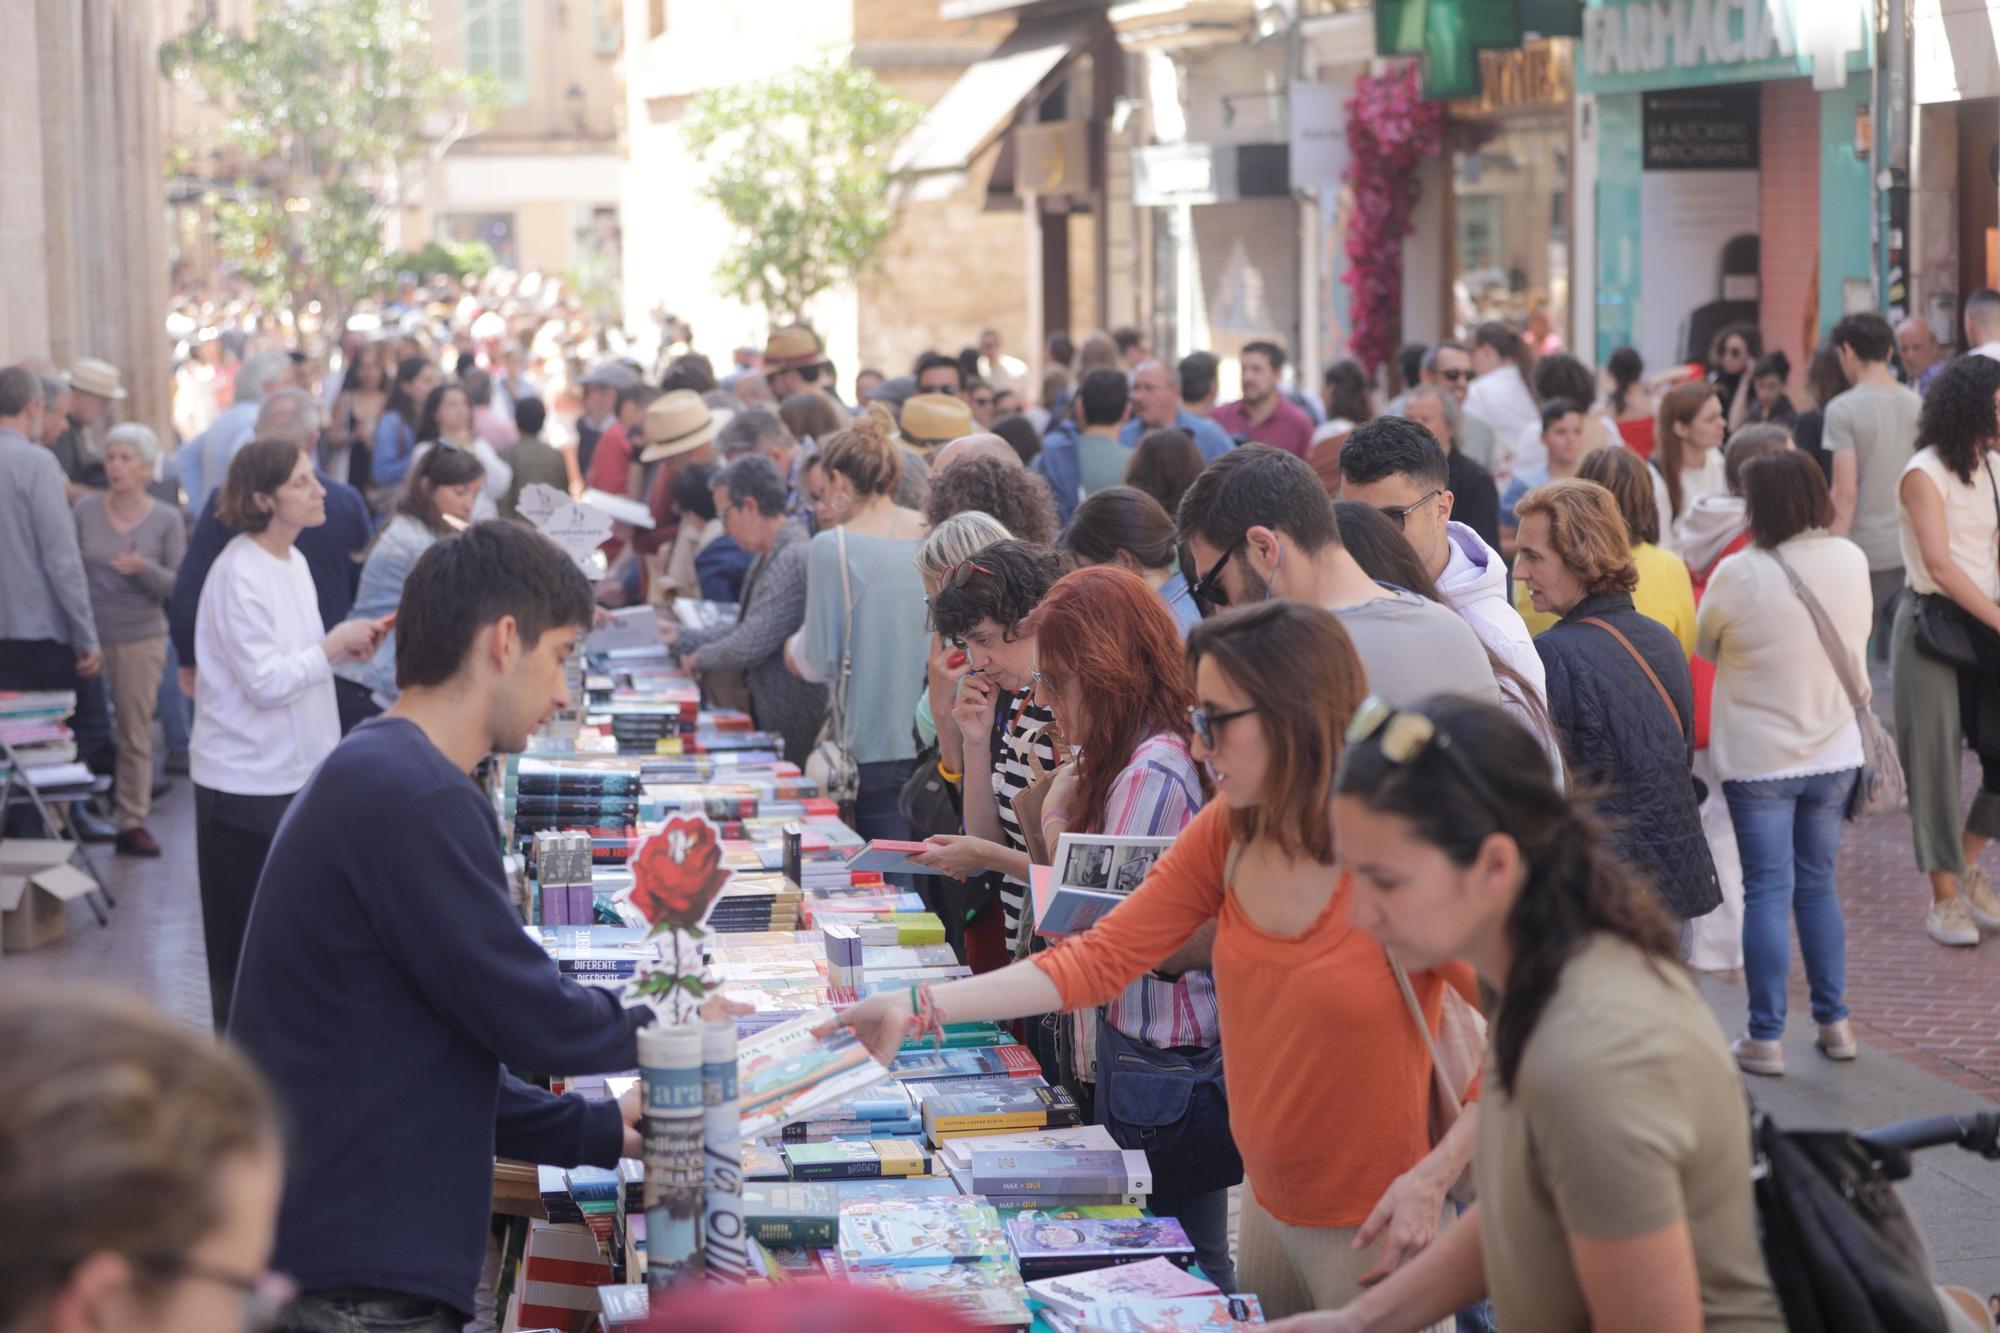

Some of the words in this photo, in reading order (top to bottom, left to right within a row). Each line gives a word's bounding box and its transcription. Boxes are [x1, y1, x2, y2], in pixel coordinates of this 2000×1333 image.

[1582, 0, 1796, 75] FARMACIA
[574, 960, 617, 970] DIFERENTE
[654, 1083, 702, 1105] ara
